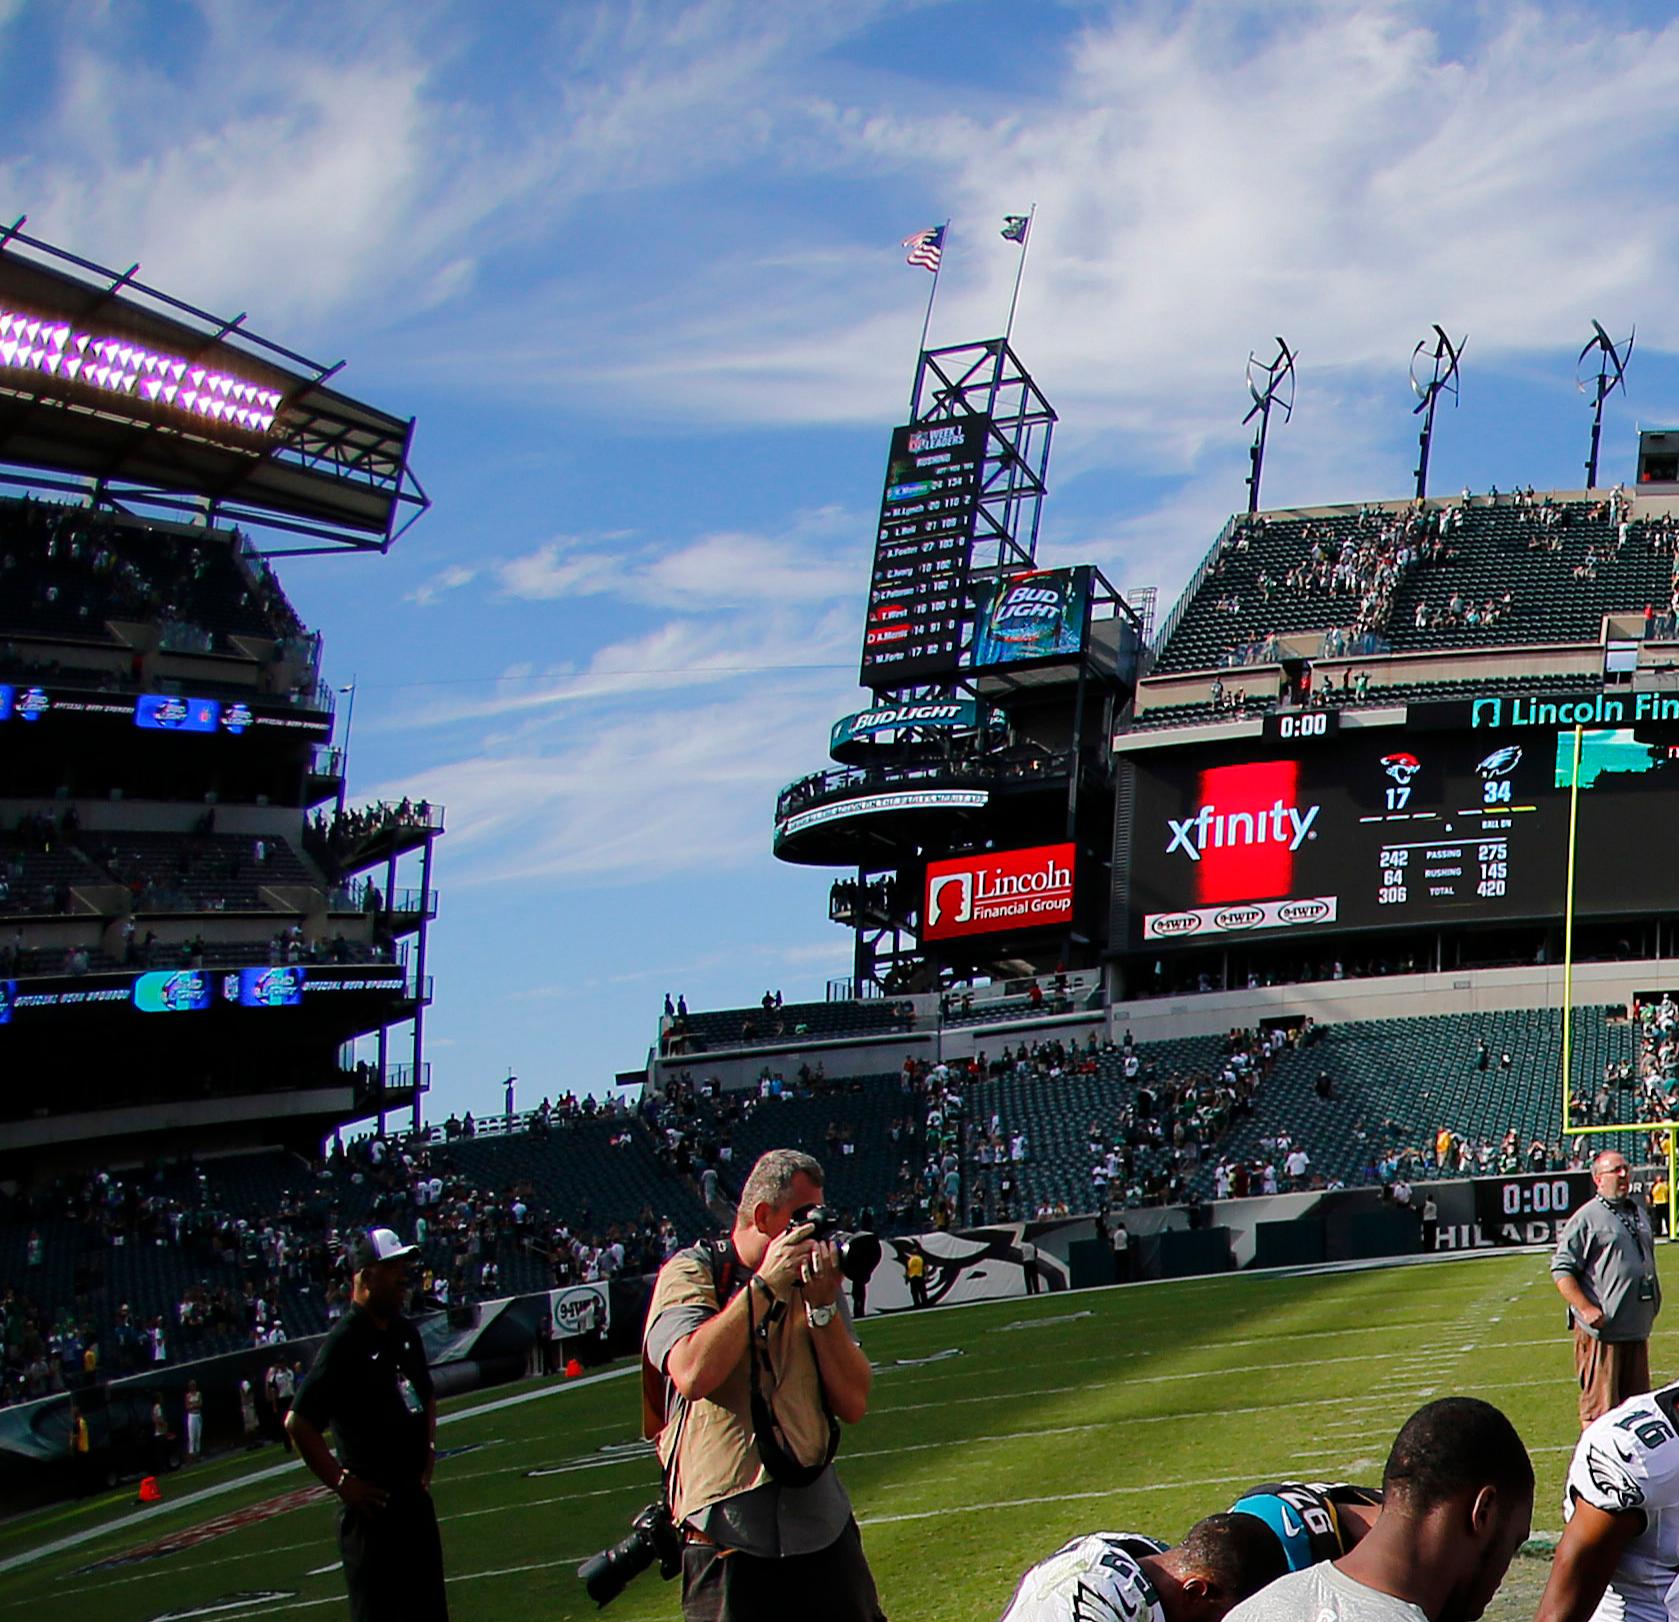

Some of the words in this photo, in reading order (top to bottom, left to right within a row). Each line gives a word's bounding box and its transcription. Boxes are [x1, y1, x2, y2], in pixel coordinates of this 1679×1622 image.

[927, 434, 965, 449] LEADERS
[930, 427, 955, 439] WEEK
[1007, 587, 1058, 604] BUD
[997, 602, 1060, 622] LIGHT
[852, 710, 899, 731] BUD
[897, 705, 961, 721] LIGHT
[1512, 694, 1622, 726] Lincoln
[1281, 713, 1327, 738] 0:00
[1386, 787, 1411, 810] 17
[1484, 780, 1511, 803] 34
[1165, 799, 1319, 861] xfinity
[1380, 851, 1408, 867] 242
[1426, 848, 1462, 860] PASSING
[1478, 844, 1507, 861] 275
[975, 860, 1071, 899] Lincoln
[1384, 869, 1403, 886] 64
[1425, 866, 1462, 878] RUSHING
[1480, 862, 1507, 880] 145
[1379, 887, 1407, 904] 306
[1429, 886, 1455, 897] TOTAL
[1477, 880, 1505, 897] 420
[974, 903, 1028, 920] Financial
[1031, 898, 1071, 913] Group
[1503, 1181, 1569, 1214] 0:00
[1612, 1409, 1675, 1450] 16
